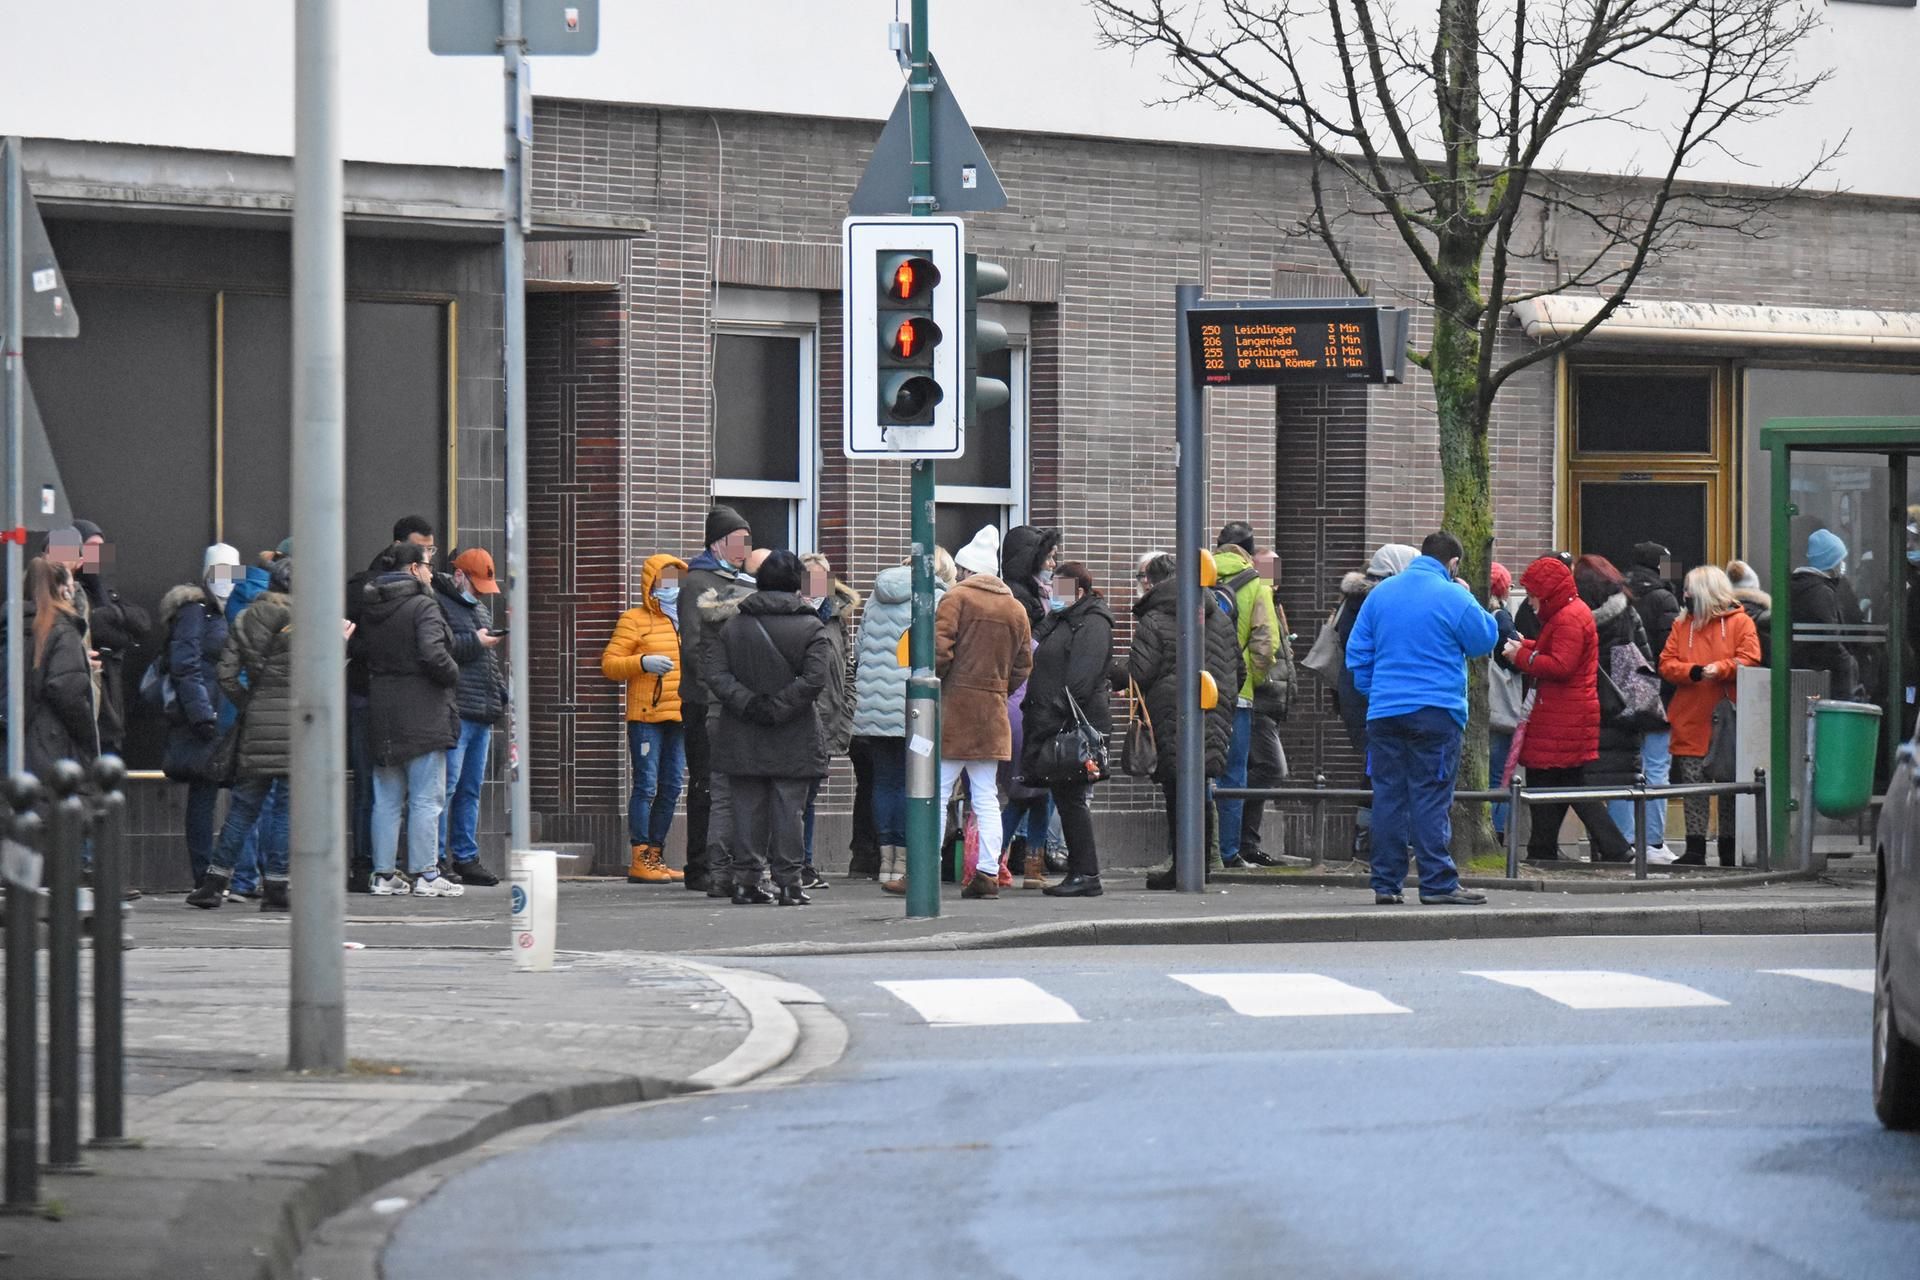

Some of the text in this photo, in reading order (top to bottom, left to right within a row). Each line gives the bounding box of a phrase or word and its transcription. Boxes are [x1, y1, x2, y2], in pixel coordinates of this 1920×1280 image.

[1202, 323, 1360, 336] 250 Leichlingen 3 Min
[1203, 335, 1361, 347] 206 Langenfeld 5 Min
[1204, 346, 1362, 359] 255 Leichlingen 10 Min
[1205, 359, 1224, 369] 202
[1255, 358, 1281, 368] Villa
[1285, 358, 1317, 368] Römer
[1326, 358, 1337, 367] 11
[1343, 357, 1363, 367] Min
